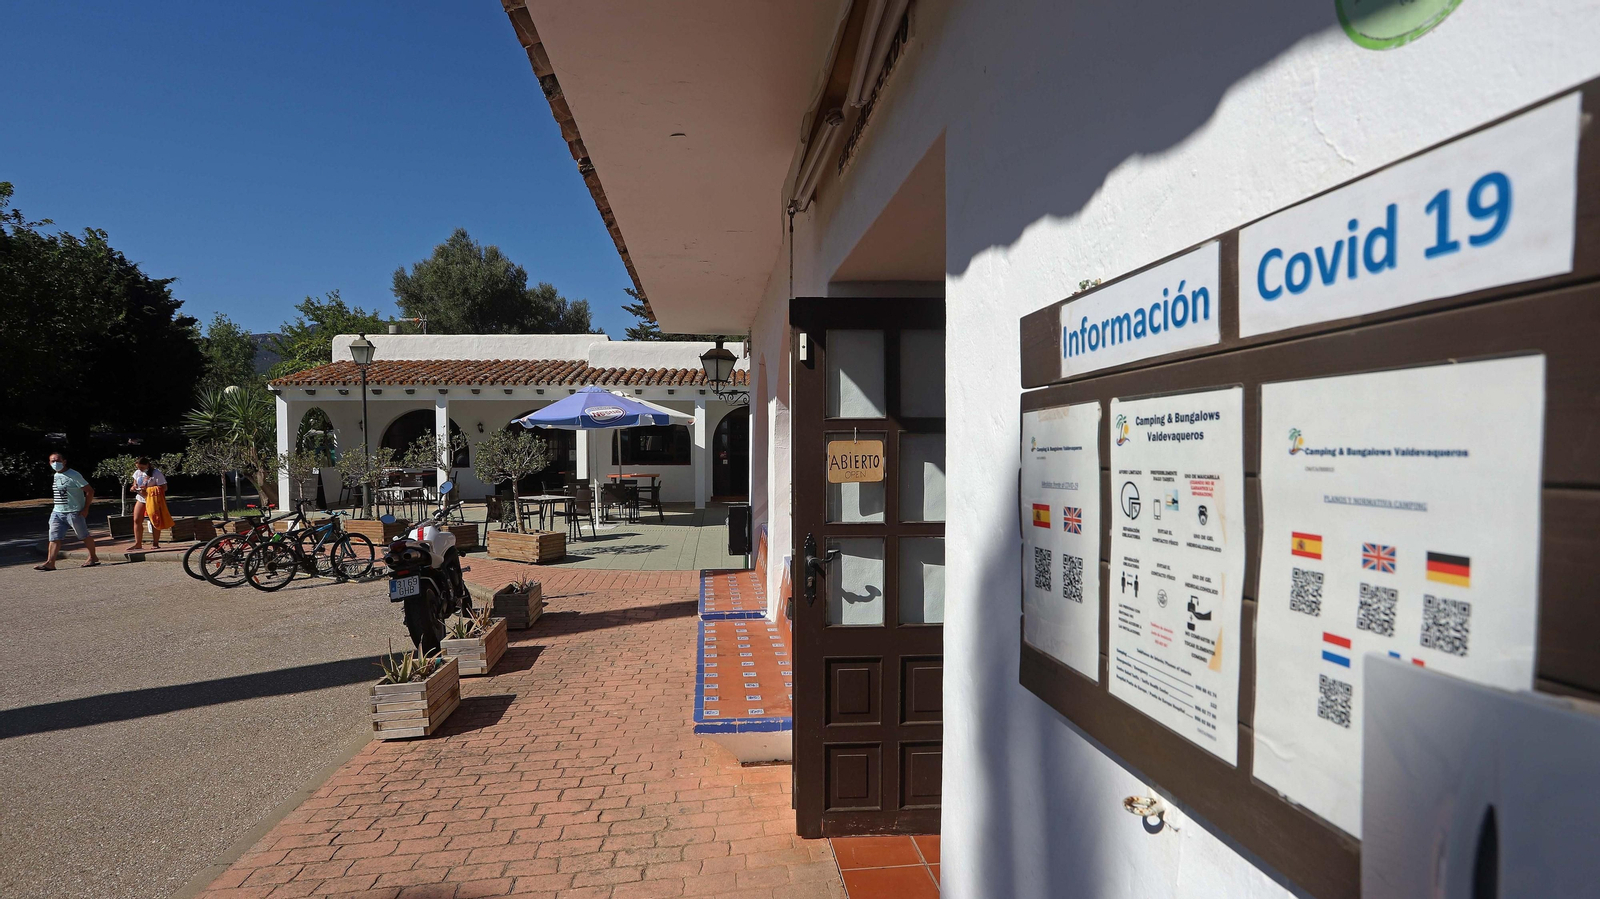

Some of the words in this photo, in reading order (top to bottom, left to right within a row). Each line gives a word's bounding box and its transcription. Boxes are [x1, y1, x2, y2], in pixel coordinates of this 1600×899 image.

[1256, 203, 1398, 301] Covid
[1424, 172, 1513, 260] 19
[1062, 280, 1210, 359] Información
[1136, 414, 1165, 427] Camping
[1167, 413, 1173, 423] &
[1174, 410, 1220, 424] Bungalows
[1147, 431, 1204, 443] Valdevaqueros
[1304, 447, 1336, 457] Camping
[1338, 447, 1344, 456] &
[1346, 447, 1392, 458] Bungalows
[1394, 448, 1470, 458] Valdevaqueros
[845, 471, 866, 479] OPEN
[397, 578, 417, 588] 3169
[400, 586, 414, 595] GHB
